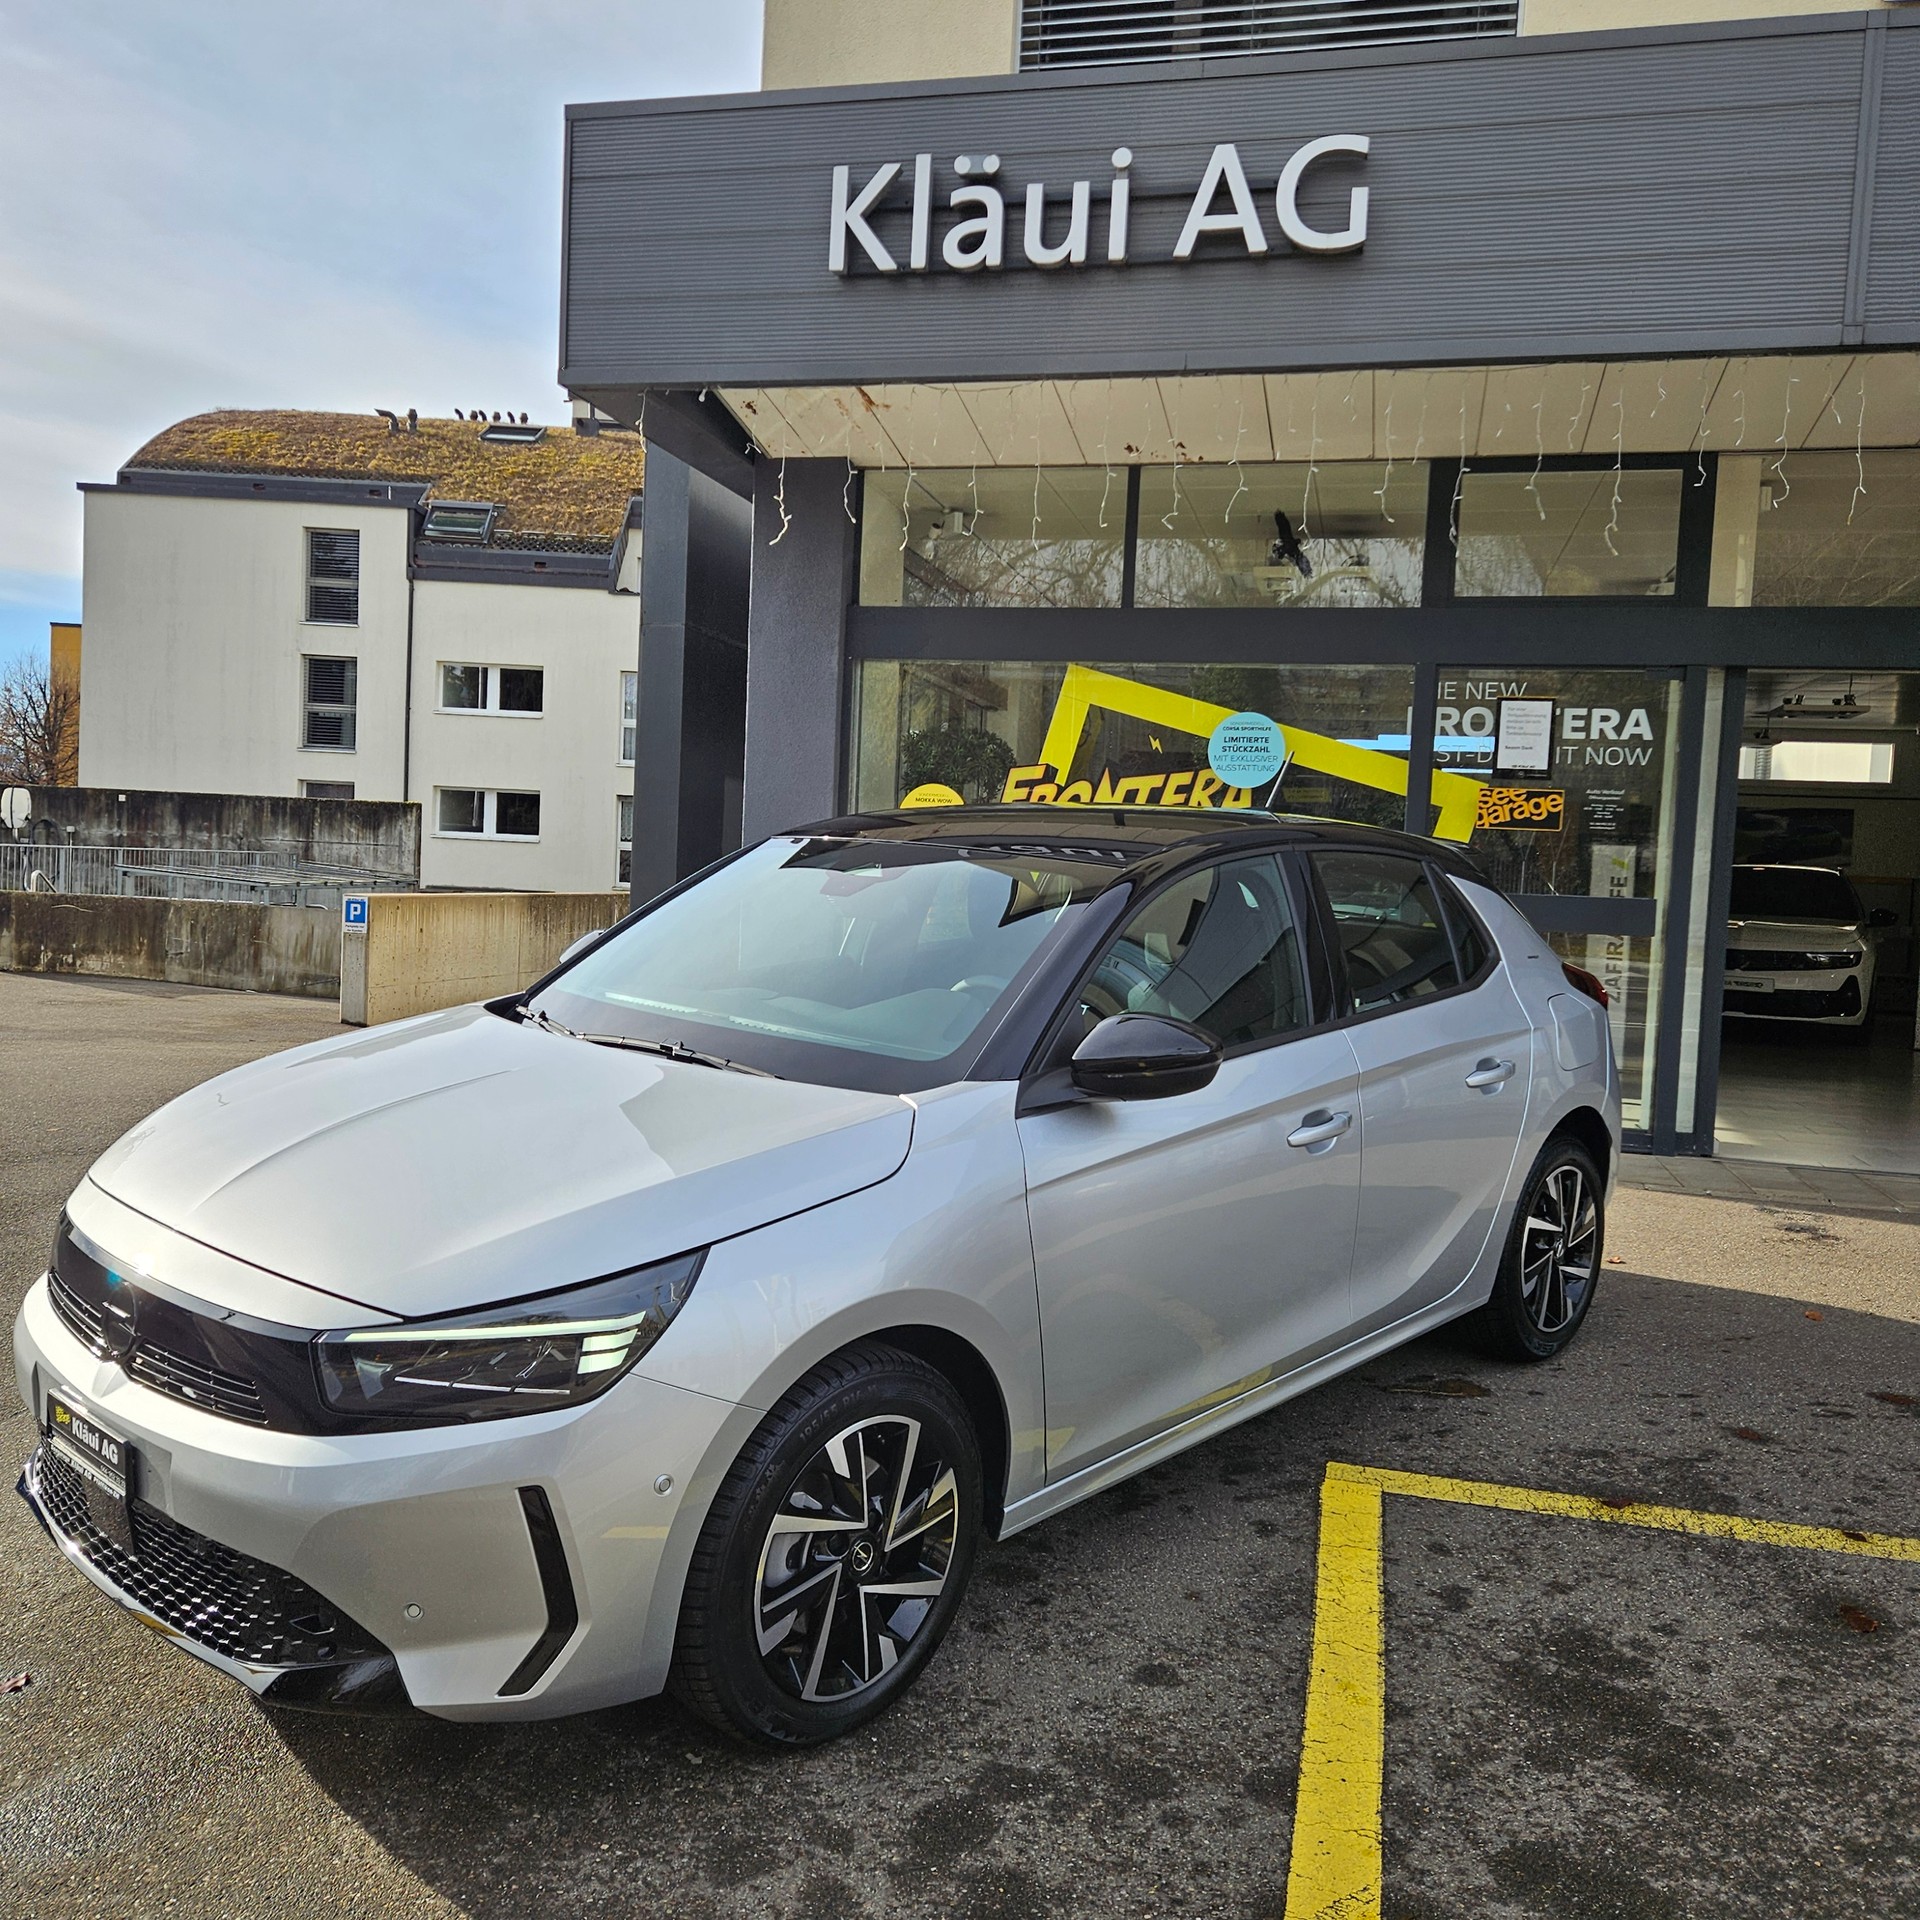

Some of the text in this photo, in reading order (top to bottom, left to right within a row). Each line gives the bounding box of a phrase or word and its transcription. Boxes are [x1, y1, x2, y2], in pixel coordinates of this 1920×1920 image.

[828, 133, 1370, 275] Kläui AG
[1466, 682, 1527, 699] NEW
[1406, 706, 1653, 740] ROERA
[1221, 744, 1270, 753] STÜCKZAHL
[1223, 736, 1270, 744] LIMITIERTE
[1230, 755, 1279, 763] EXKLUSIVER
[1585, 746, 1653, 766] NOW
[1216, 764, 1275, 772] AUSSTATTUNG
[1478, 787, 1528, 809] see
[1476, 794, 1563, 829] garage
[350, 903, 361, 921] P
[71, 1416, 100, 1452] Kläui
[101, 1438, 119, 1465] AG
